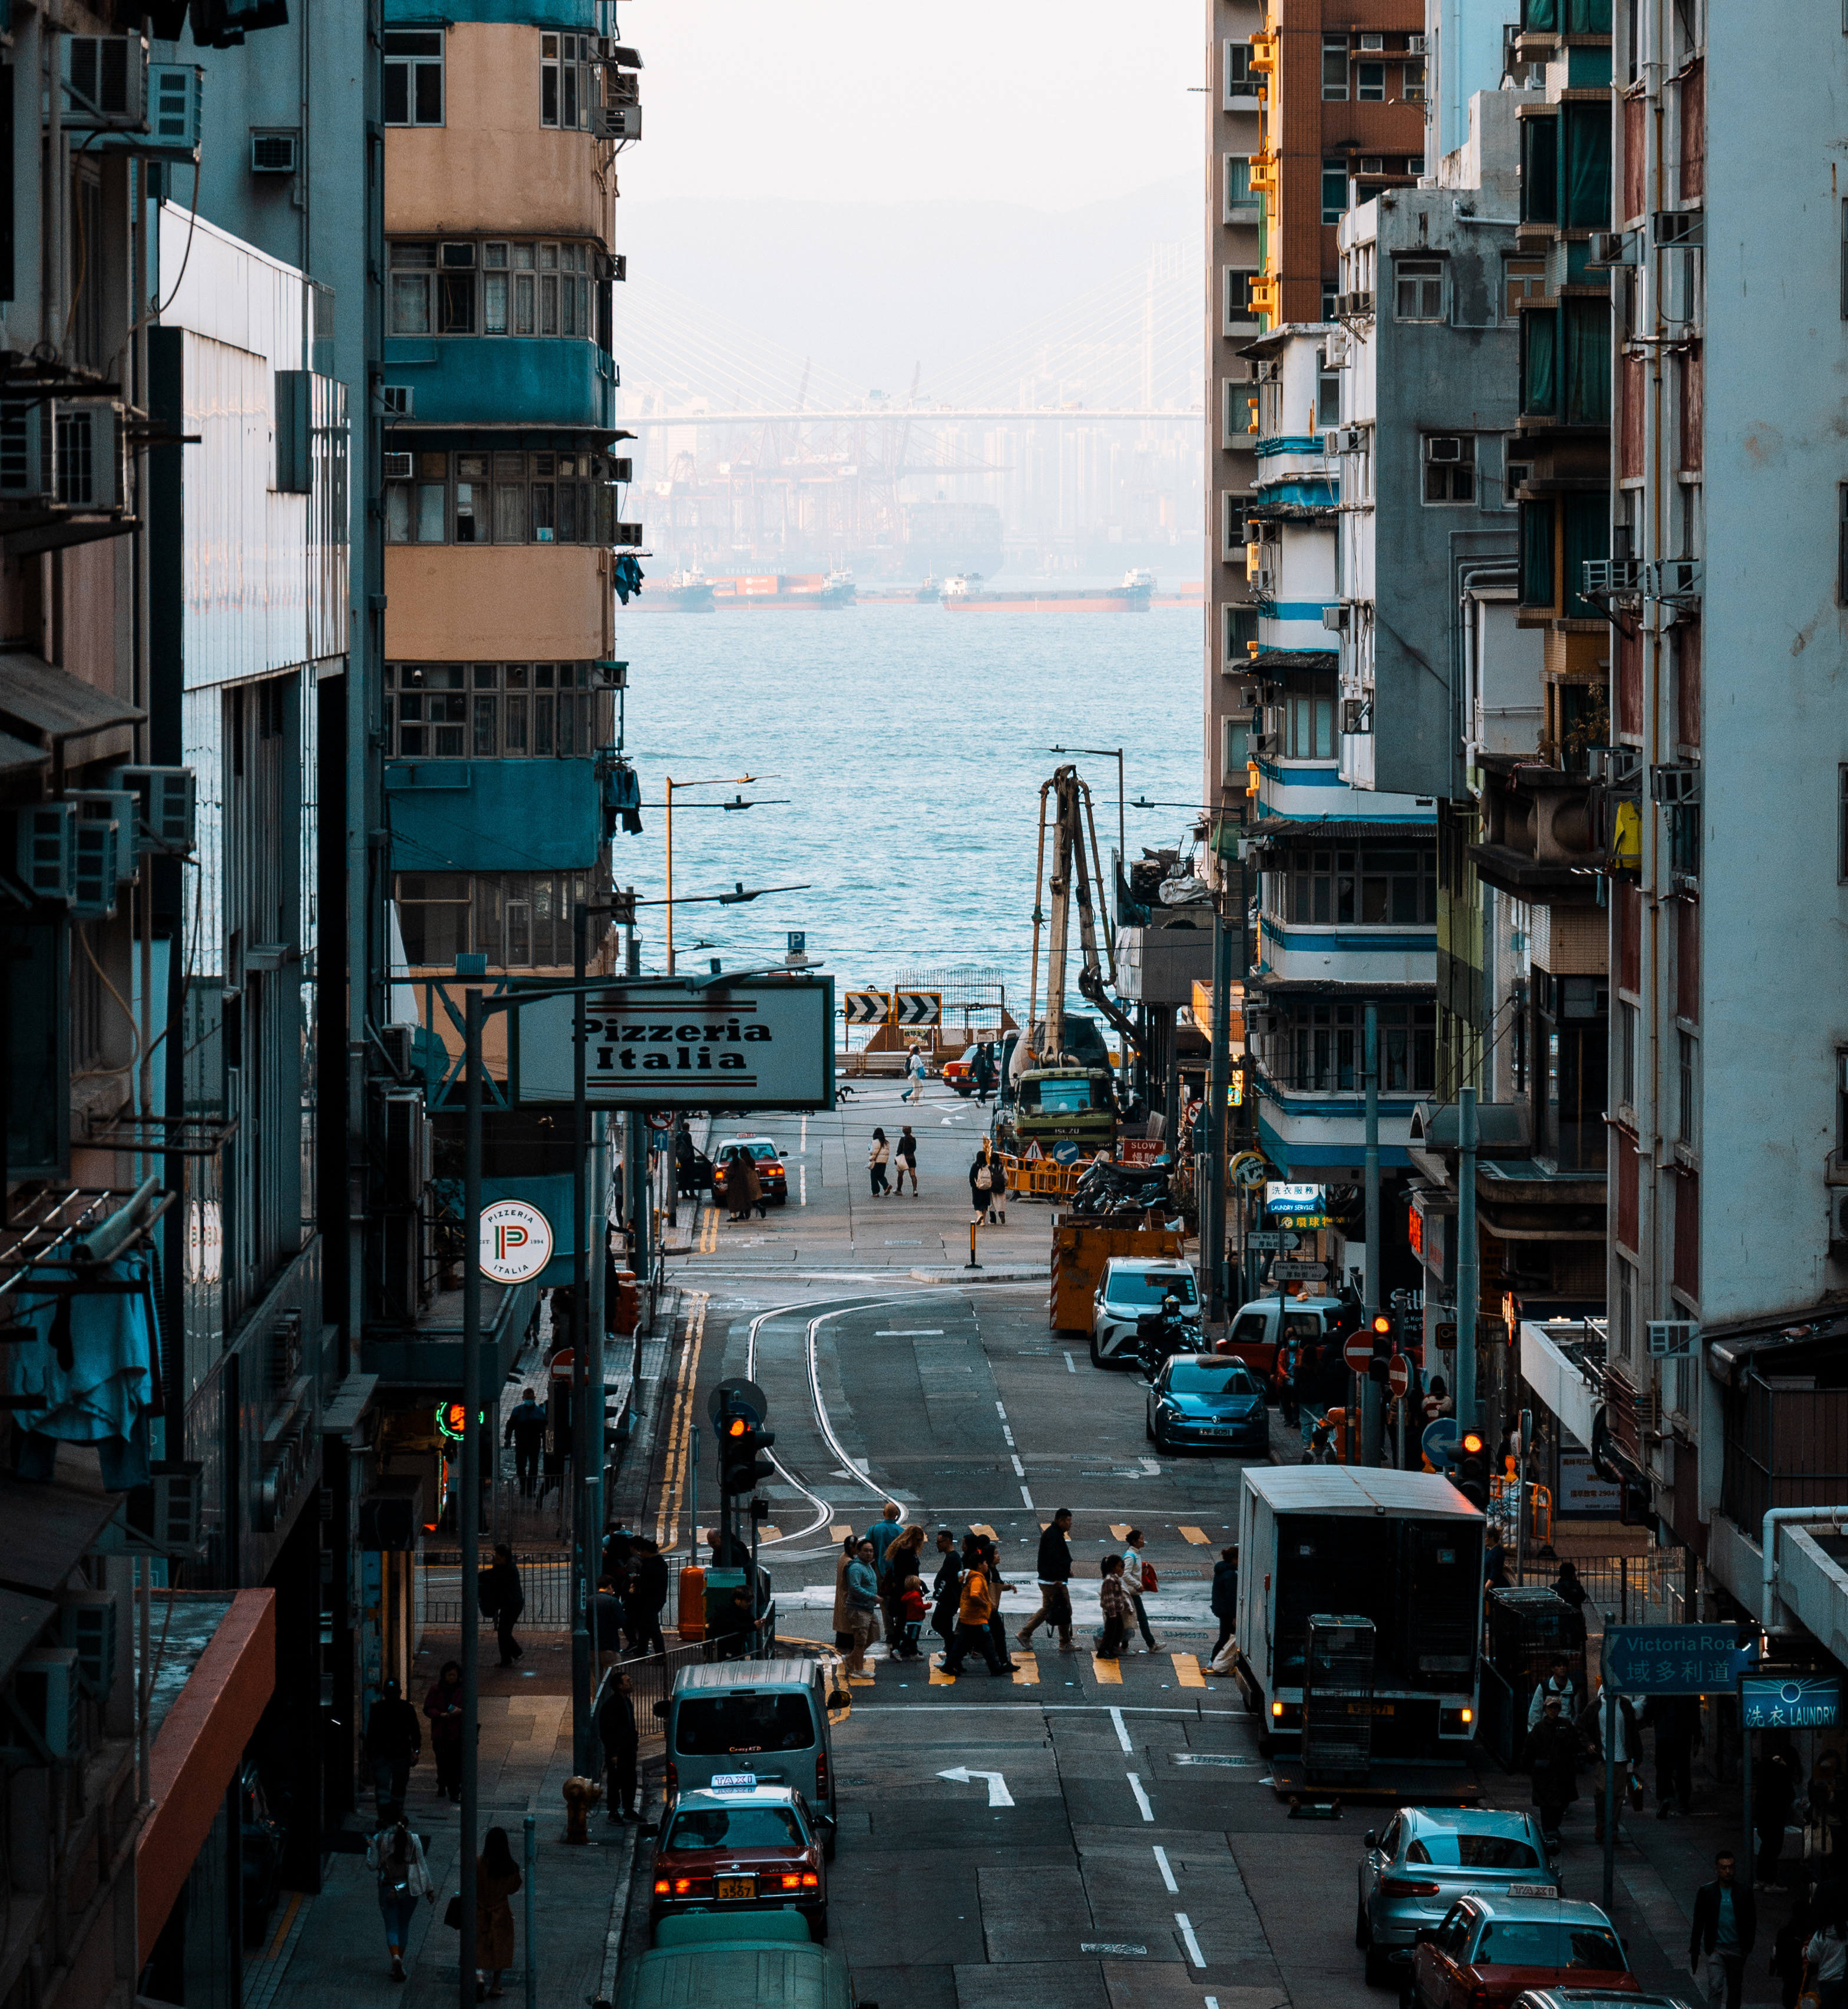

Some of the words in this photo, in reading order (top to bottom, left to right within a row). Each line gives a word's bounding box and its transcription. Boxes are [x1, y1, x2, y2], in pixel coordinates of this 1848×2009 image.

[791, 933, 802, 946] P
[571, 1018, 772, 1042] Pizzeria
[597, 1046, 746, 1070] Italia
[1272, 1186, 1314, 1195] 洗衣服務
[488, 1210, 533, 1223] PIZZERIA
[494, 1265, 528, 1275] ITALIA
[1626, 1636, 1696, 1651] Victoria
[1700, 1636, 1736, 1651] Roa
[1626, 1660, 1730, 1683] 域多利道
[1745, 1704, 1787, 1727] 洗衣
[1790, 1706, 1836, 1726] LAUNDRY
[715, 1776, 753, 1785] TAXI
[730, 1879, 743, 1888] JZ
[722, 1888, 752, 1897] 3567
[1513, 1886, 1554, 1896] TAXI
